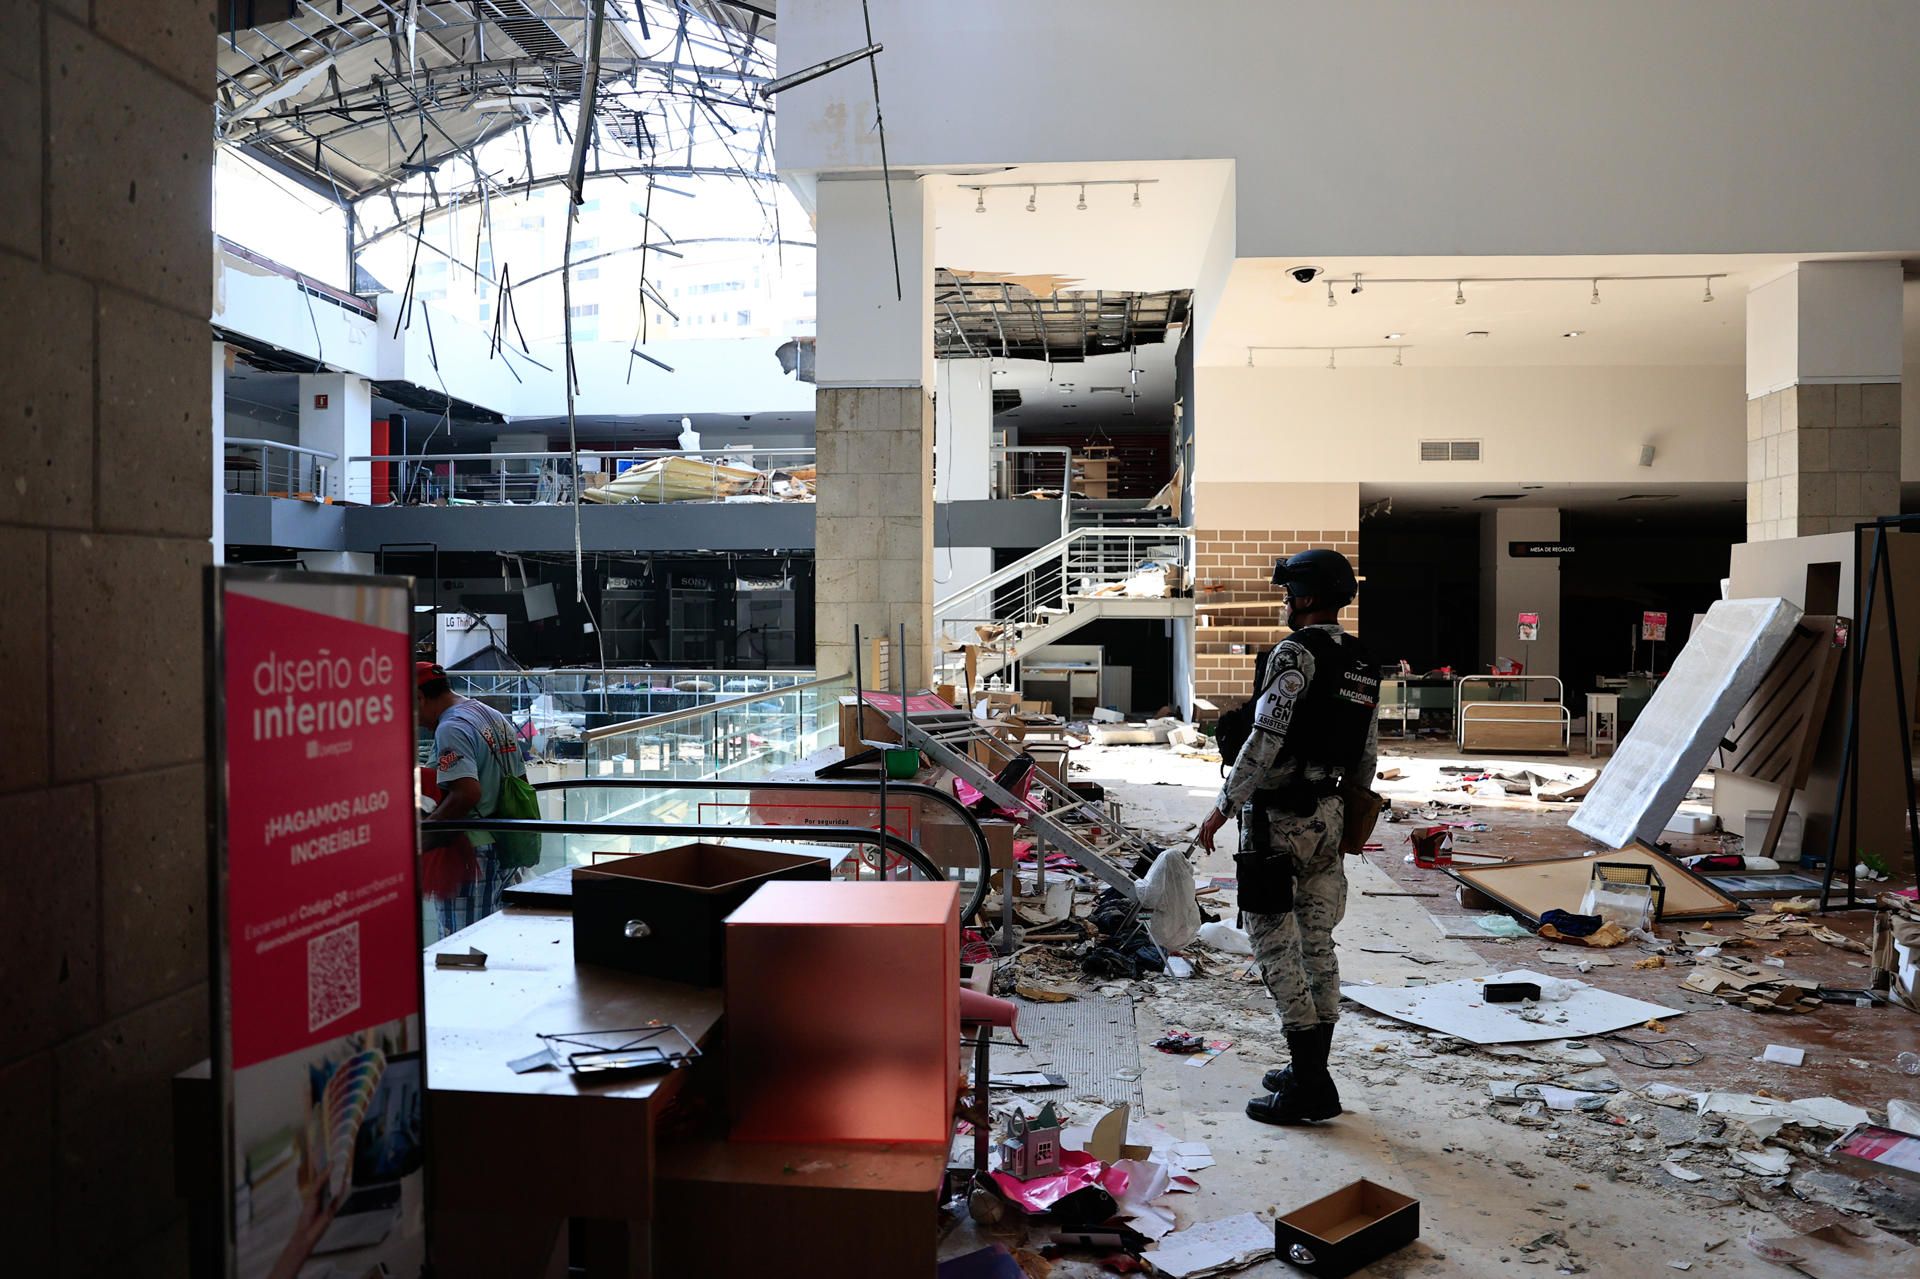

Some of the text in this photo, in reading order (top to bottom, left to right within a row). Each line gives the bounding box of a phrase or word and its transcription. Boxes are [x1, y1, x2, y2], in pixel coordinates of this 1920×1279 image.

[614, 577, 645, 587] SONY
[681, 577, 708, 587] SONY
[446, 616, 455, 628] LG
[253, 647, 393, 697] diseño de
[1344, 671, 1378, 687] GUARDIA
[1339, 687, 1374, 704] NACIONAL
[253, 693, 395, 741] interiores
[1272, 703, 1291, 721] GN
[264, 790, 390, 846] ¡HAGAMOS ALGO
[817, 818, 849, 826] seguridad
[290, 824, 371, 867] INCREÍBLE!
[333, 889, 348, 908] QR
